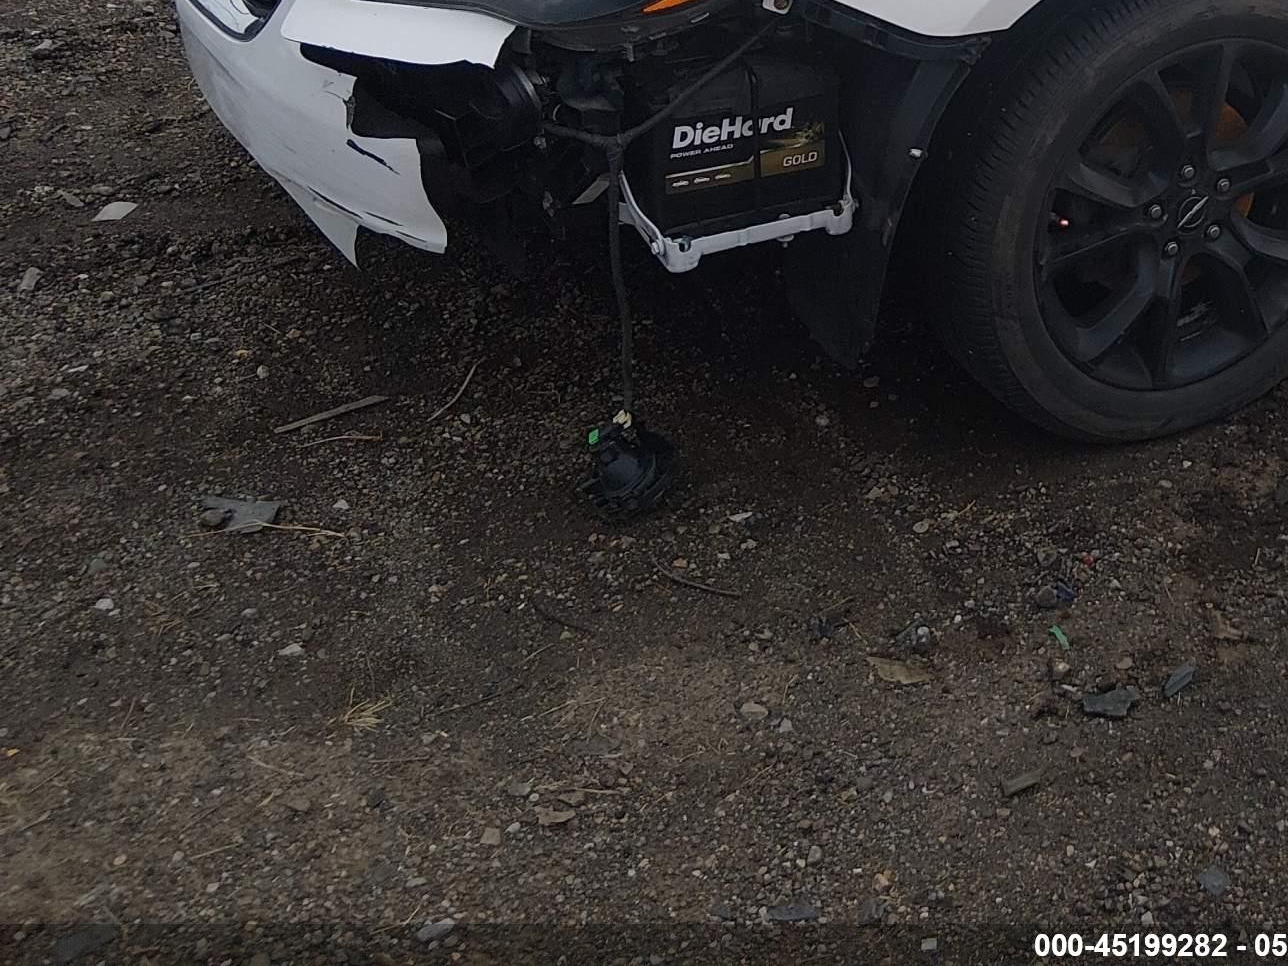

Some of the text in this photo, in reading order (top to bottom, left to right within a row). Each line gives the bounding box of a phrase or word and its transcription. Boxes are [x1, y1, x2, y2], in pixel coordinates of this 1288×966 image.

[672, 107, 794, 149] DieHard
[670, 143, 734, 159] POWER AHEAD
[783, 151, 818, 167] GOLD
